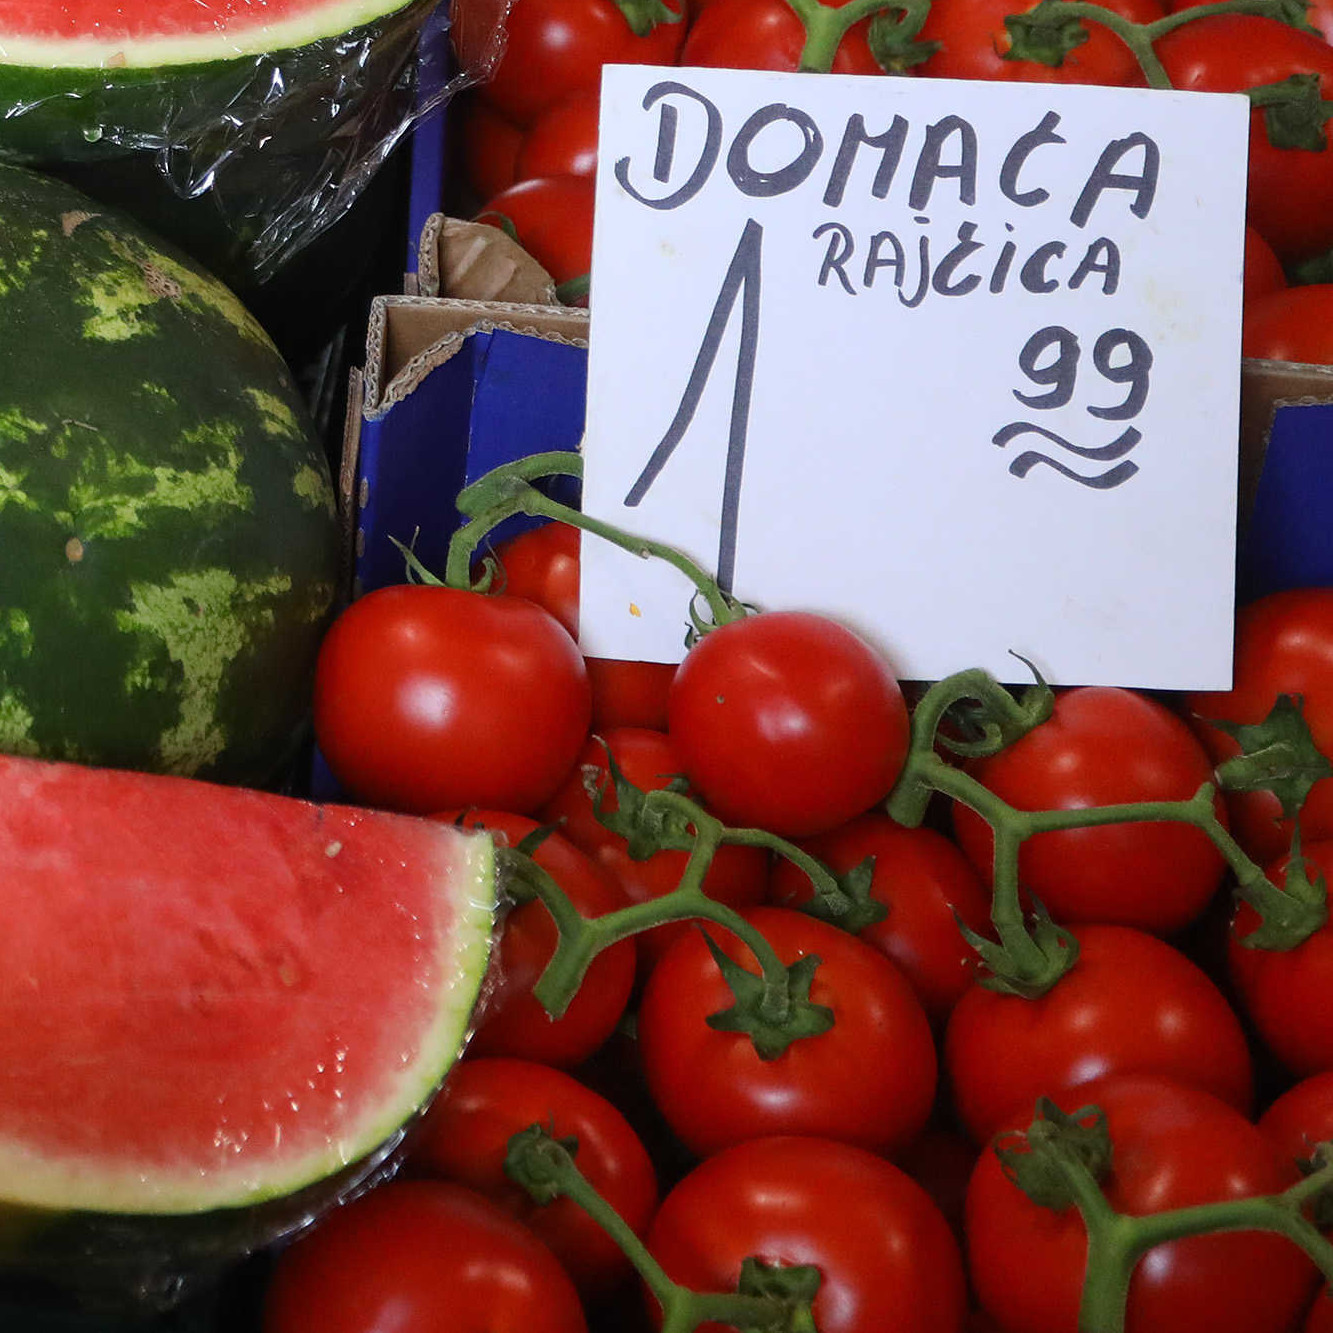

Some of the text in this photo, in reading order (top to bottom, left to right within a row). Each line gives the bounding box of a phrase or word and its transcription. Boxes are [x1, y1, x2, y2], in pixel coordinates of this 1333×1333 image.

[614, 80, 1161, 229] DOMAĆA
[623, 217, 1154, 597] 1 99
